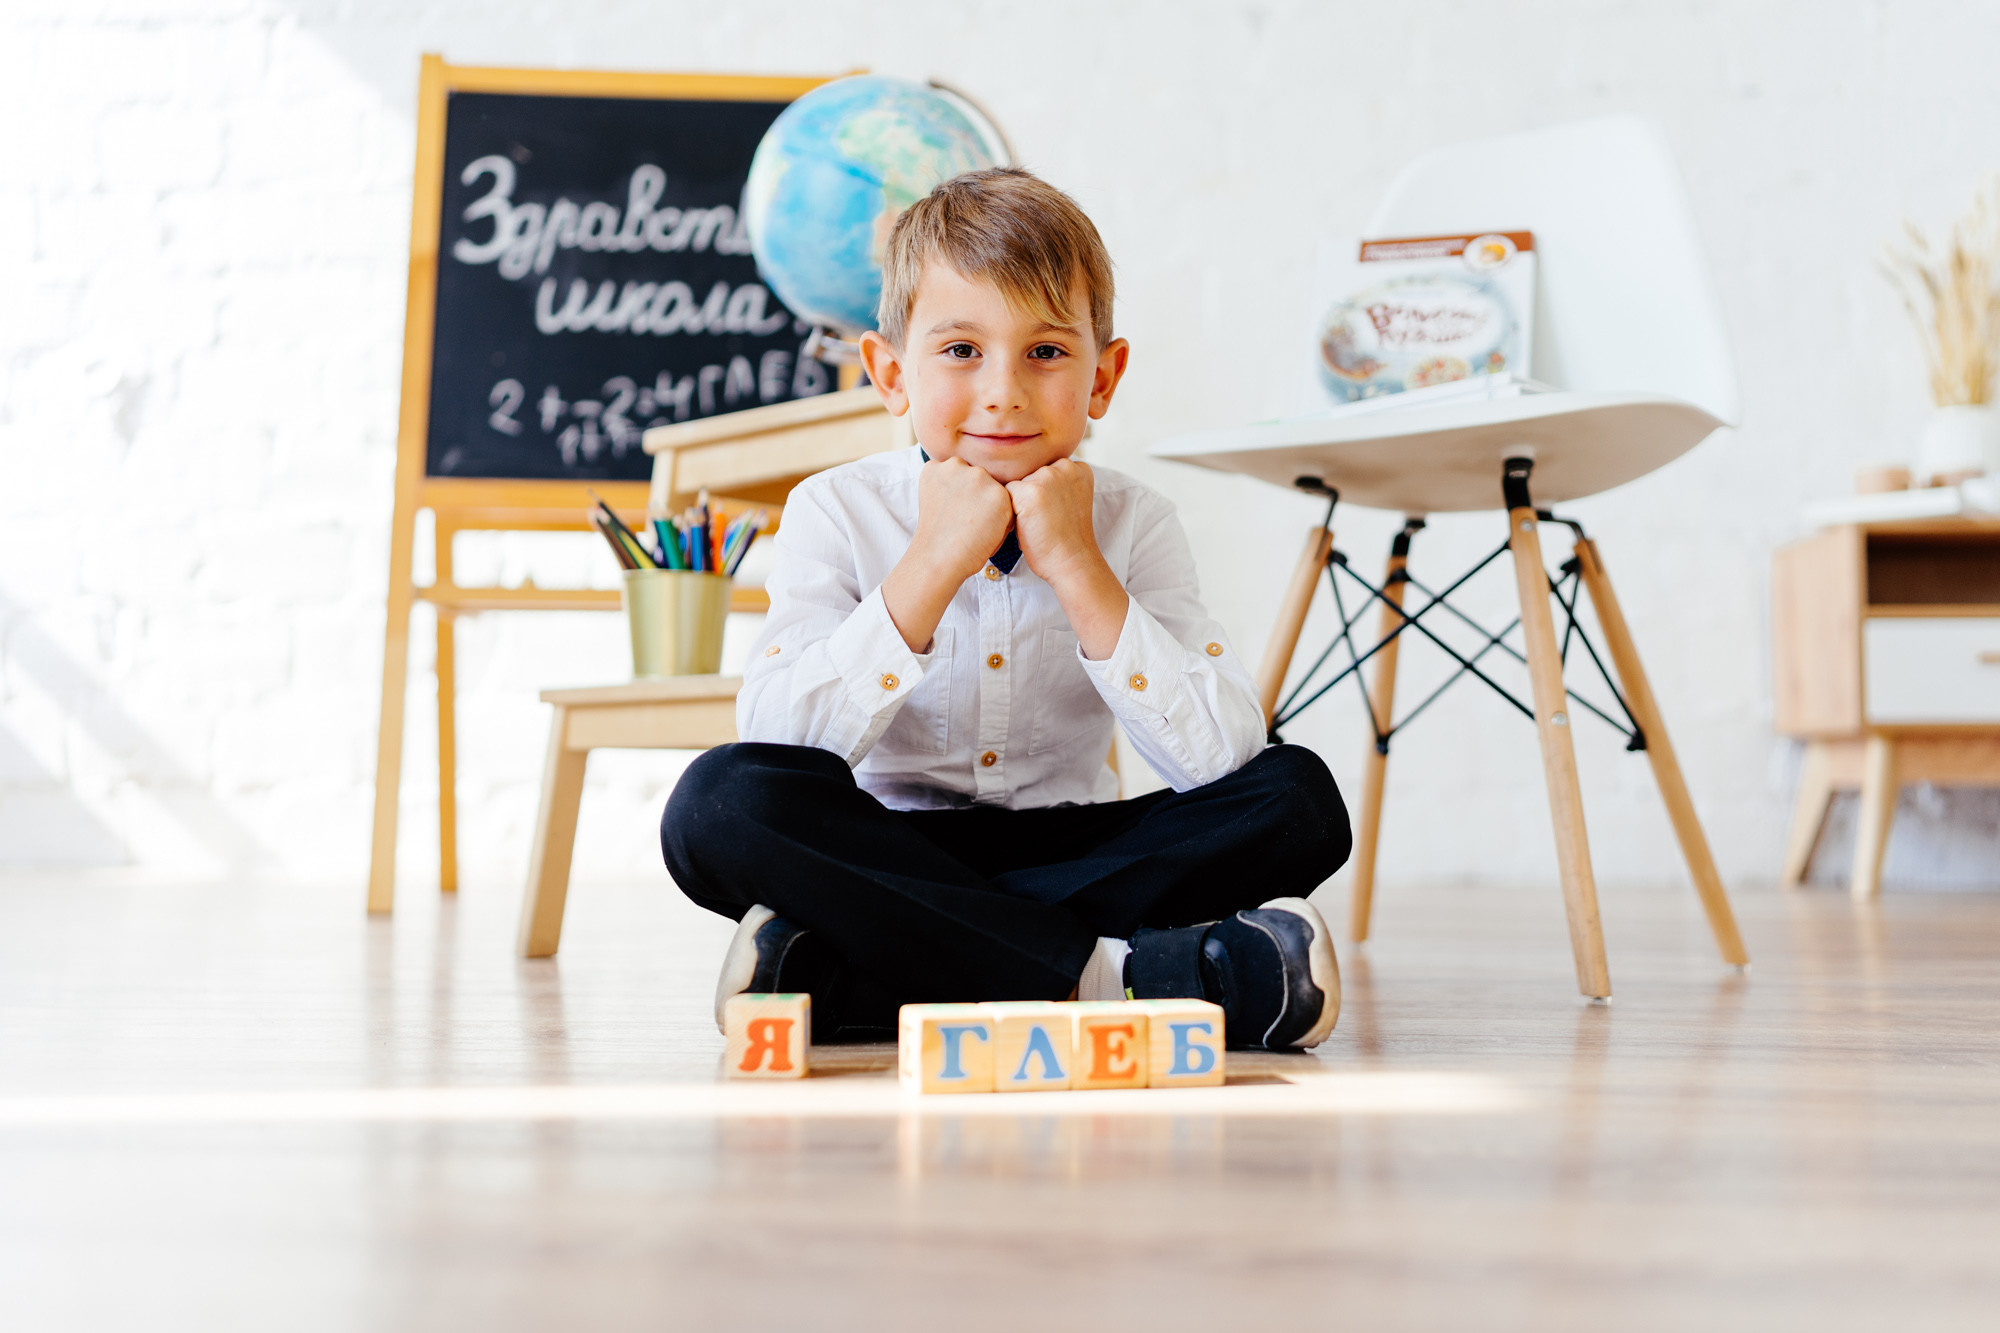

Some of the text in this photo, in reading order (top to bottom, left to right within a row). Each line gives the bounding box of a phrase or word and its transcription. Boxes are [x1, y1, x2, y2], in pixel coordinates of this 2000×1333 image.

[535, 276, 809, 336] школа
[738, 1017, 1217, 1081] Я ГЛЕБ
